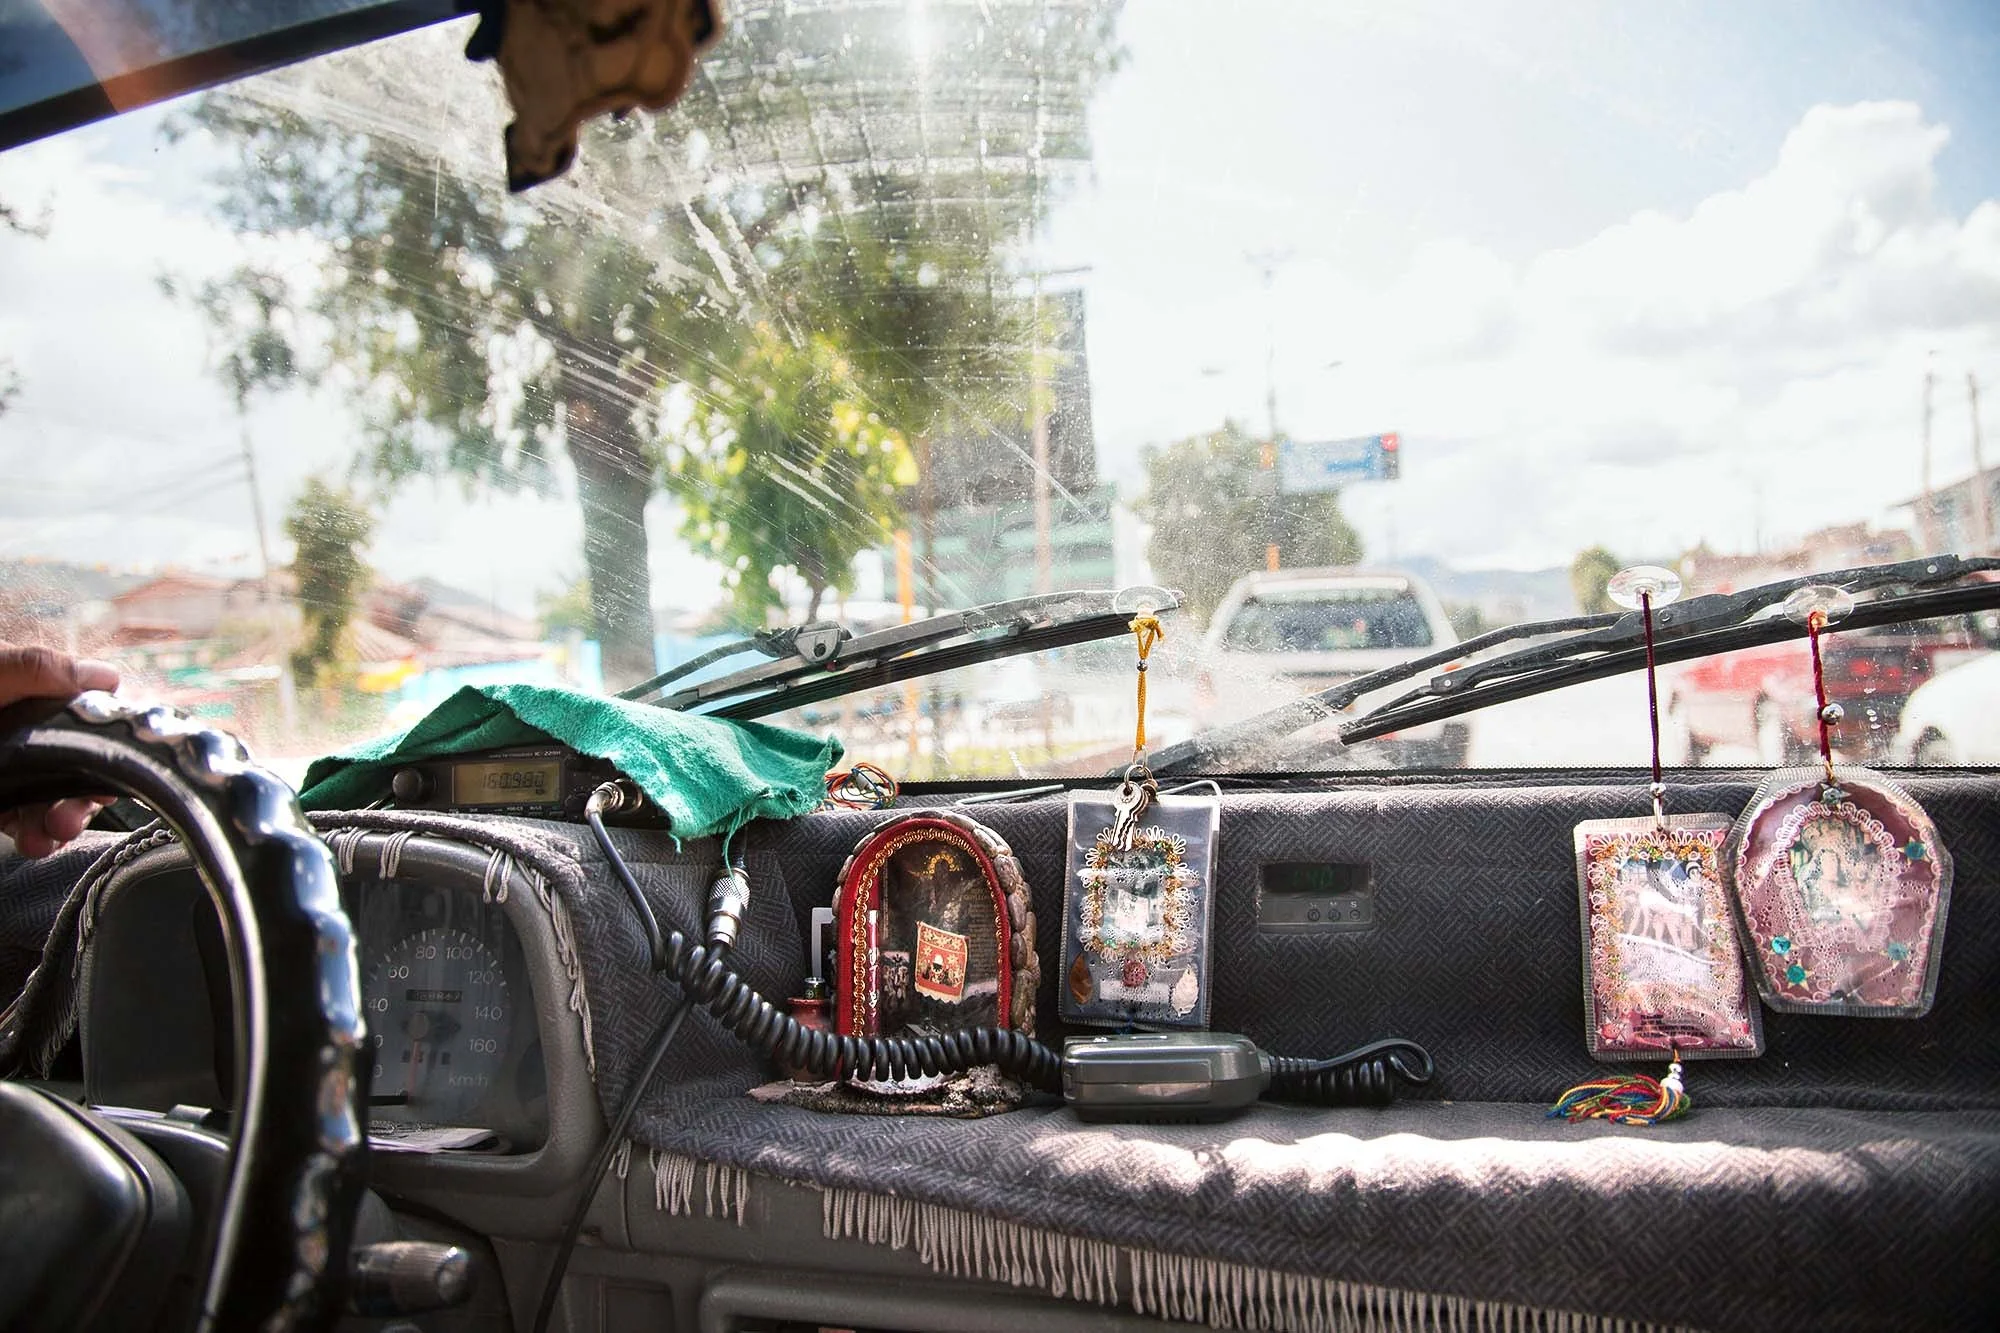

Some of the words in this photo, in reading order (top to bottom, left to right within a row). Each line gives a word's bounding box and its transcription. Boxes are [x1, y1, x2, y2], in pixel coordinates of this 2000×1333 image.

[415, 945, 437, 960] 80
[446, 946, 473, 960] 100
[468, 970, 494, 984] 120
[368, 998, 389, 1012] 40
[474, 1006, 503, 1020] 140
[469, 1038, 497, 1053] 160
